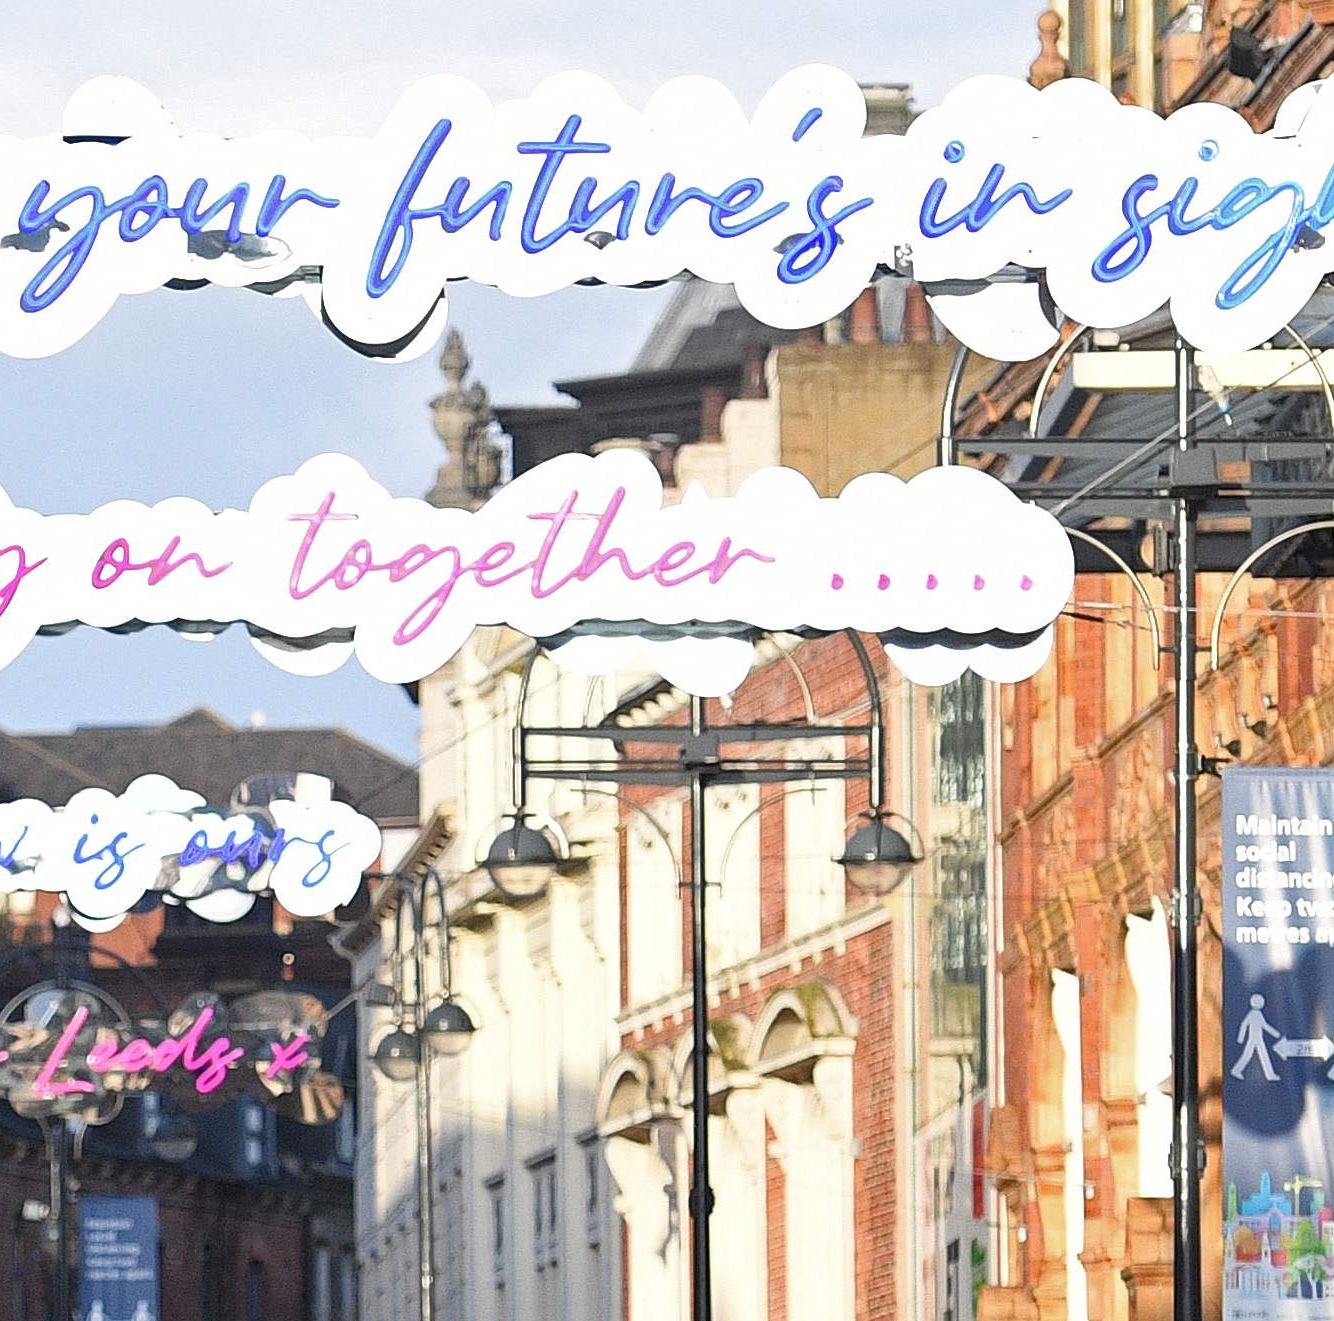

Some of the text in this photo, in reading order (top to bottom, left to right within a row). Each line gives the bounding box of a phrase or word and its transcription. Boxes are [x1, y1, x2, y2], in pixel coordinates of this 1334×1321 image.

[19, 172, 339, 312] your
[367, 106, 873, 298] future's
[919, 140, 1072, 240] in
[92, 534, 234, 590] on
[289, 486, 775, 646] together
[73, 811, 150, 889] is
[178, 819, 352, 885] ours
[1235, 814, 1334, 836] Maintain
[1235, 841, 1297, 862] social
[1235, 925, 1310, 943] mees
[1236, 896, 1292, 922] Kep
[39, 1006, 244, 1095] Leeds
